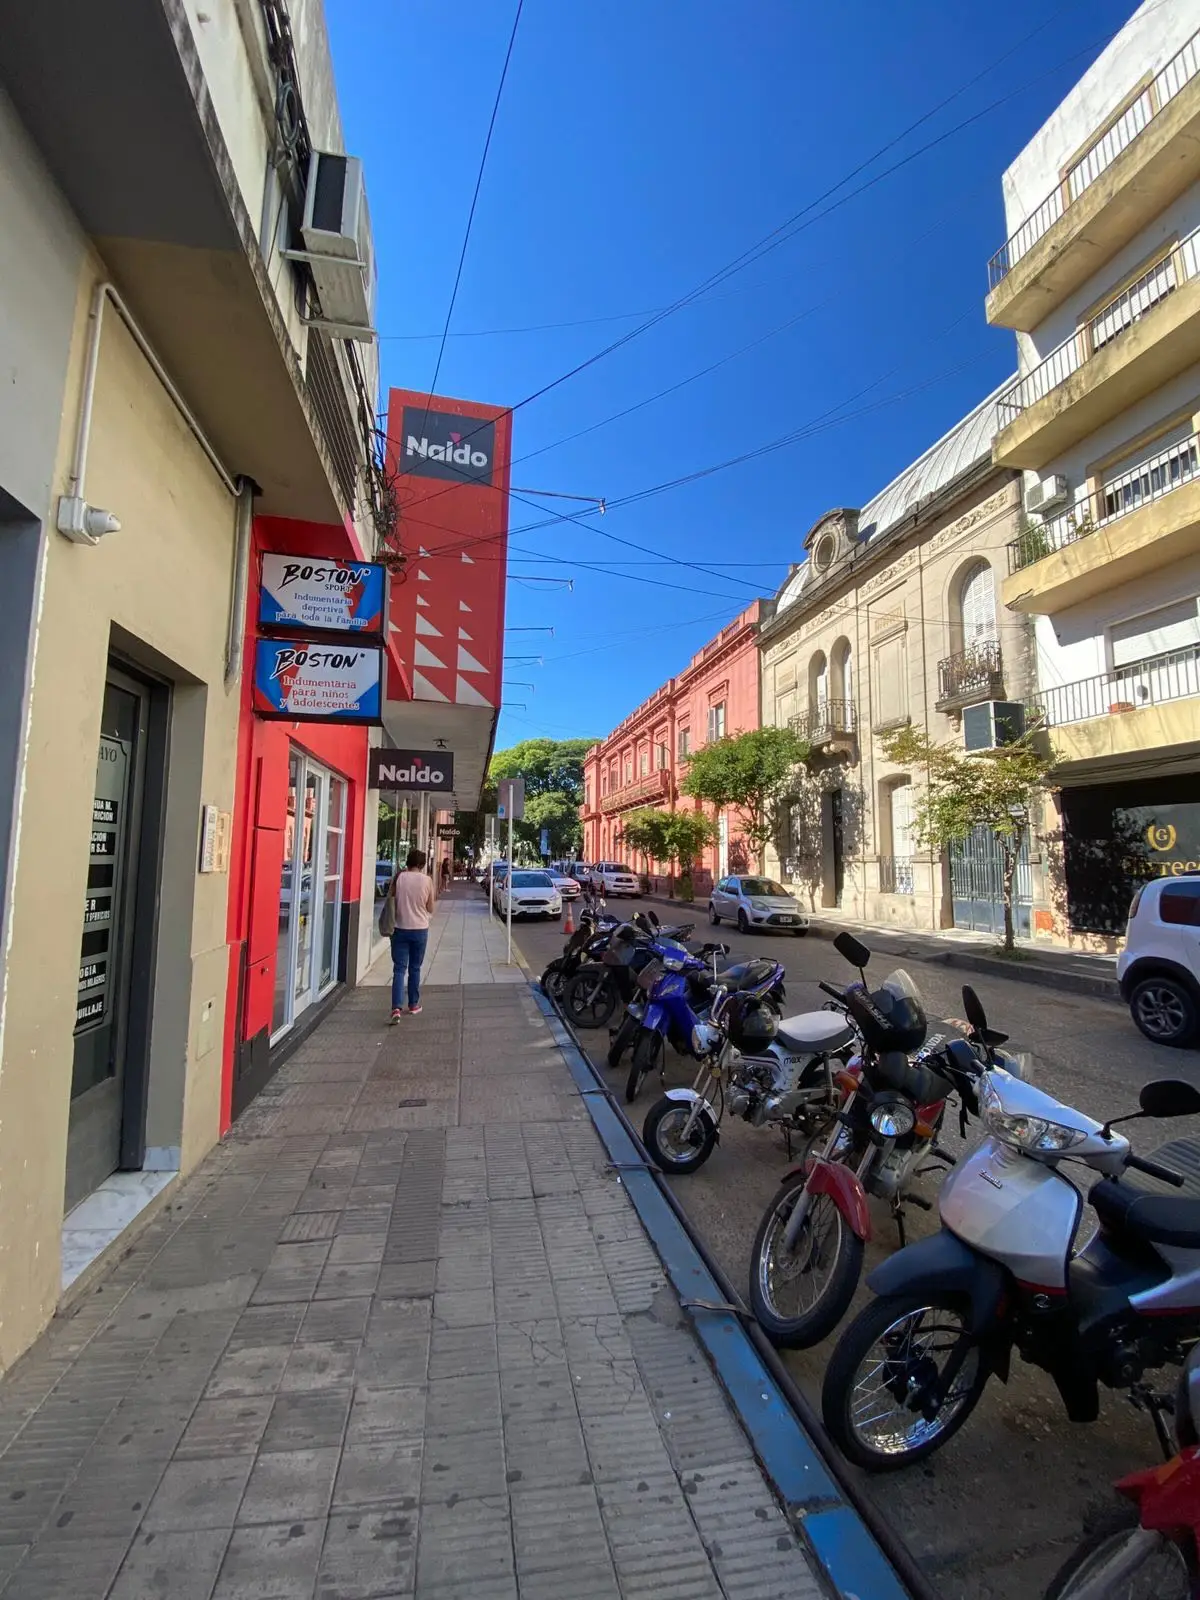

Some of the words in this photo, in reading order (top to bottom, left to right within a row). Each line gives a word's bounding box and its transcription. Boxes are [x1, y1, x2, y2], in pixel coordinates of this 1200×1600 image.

[406, 435, 488, 467] Naldo
[277, 564, 362, 590] BOSTON
[324, 583, 353, 593] SPORT
[301, 603, 344, 615] deportiva
[270, 649, 359, 680] BOSTON
[283, 676, 357, 689] Indumentaria
[292, 689, 316, 698] para
[280, 698, 288, 708] y
[293, 698, 360, 710] adolescentes
[378, 764, 444, 783] Naldo
